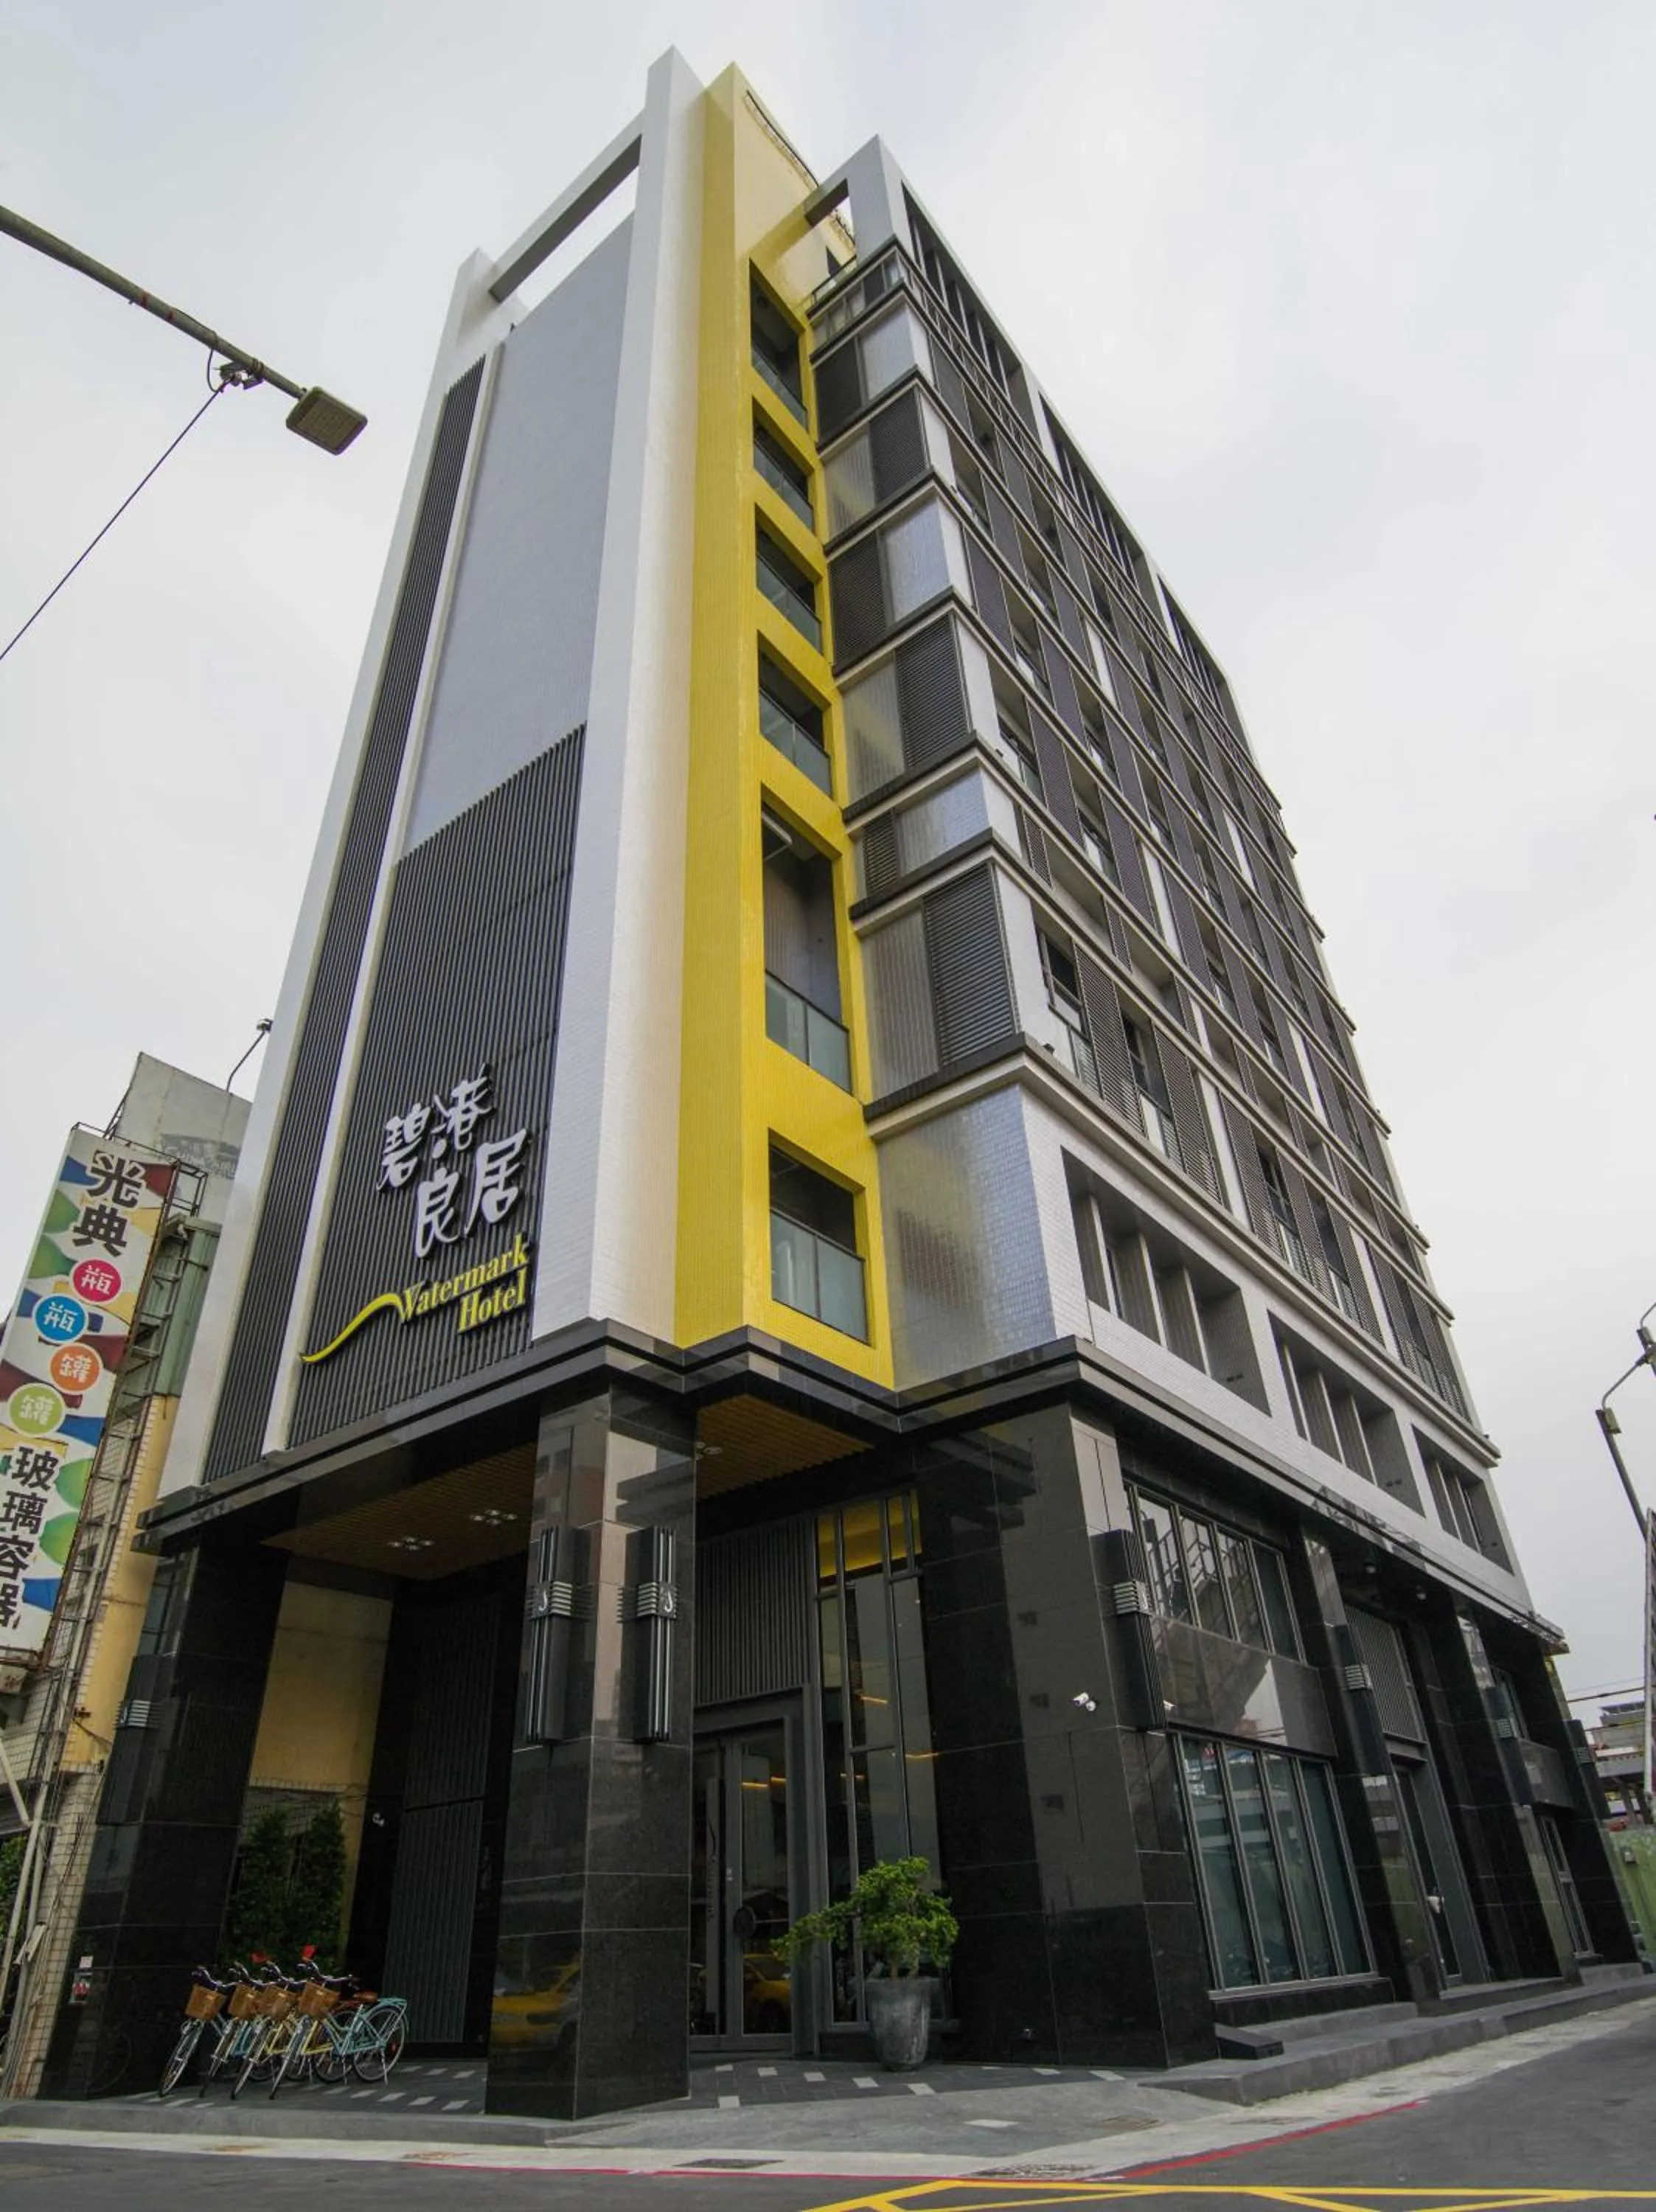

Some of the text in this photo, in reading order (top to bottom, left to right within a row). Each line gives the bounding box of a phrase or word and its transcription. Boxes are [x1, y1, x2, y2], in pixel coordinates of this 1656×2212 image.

[72, 1156, 142, 1257] 光典
[414, 1128, 529, 1258] 良居
[457, 1265, 529, 1333] Hotel
